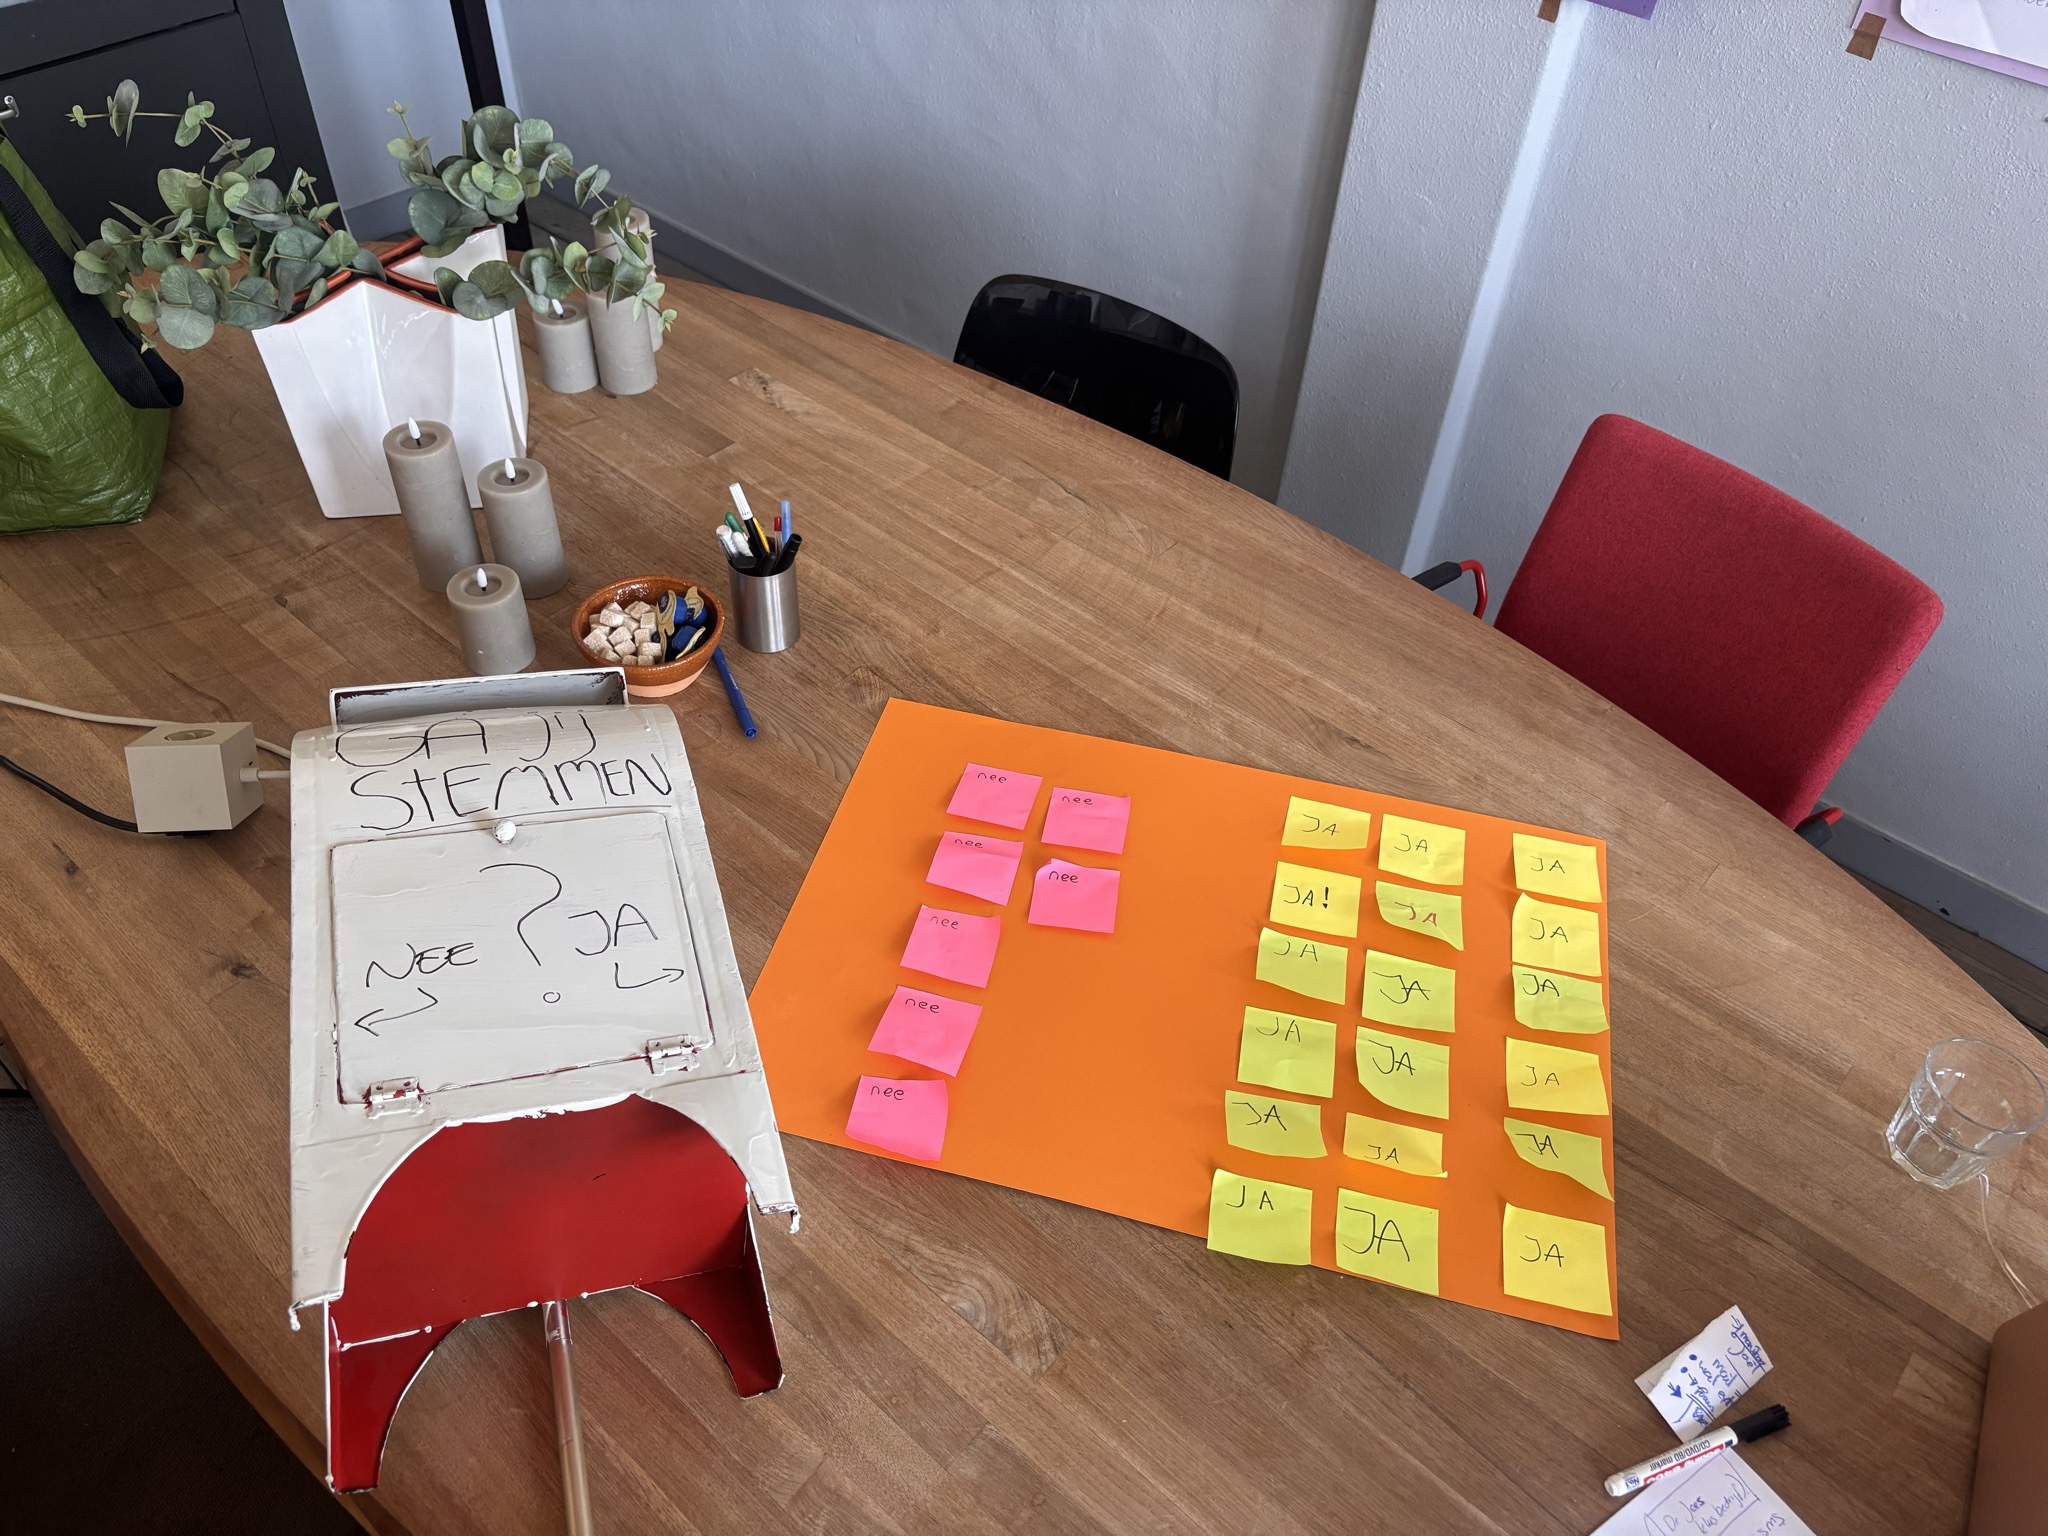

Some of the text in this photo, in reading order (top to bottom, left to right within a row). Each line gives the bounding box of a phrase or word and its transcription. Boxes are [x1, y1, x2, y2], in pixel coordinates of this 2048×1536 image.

[335, 717, 488, 768] GA
[977, 771, 1007, 784] nee
[350, 752, 672, 830] STEMMEN
[1061, 795, 1093, 806] nee
[1302, 813, 1341, 837] JA
[954, 838, 983, 849] nee
[1393, 832, 1429, 853] JA
[1048, 870, 1079, 884] nee
[1530, 856, 1566, 874] JA
[1283, 883, 1330, 910] JA!
[929, 915, 959, 931] nee
[1394, 901, 1438, 927] JA
[568, 903, 659, 956] JA
[1529, 917, 1569, 944] JA
[1273, 940, 1319, 963] JA
[366, 942, 479, 988] NEE
[1372, 971, 1431, 1005] JA
[1521, 973, 1561, 998] JA
[904, 998, 940, 1014] nee
[1255, 1016, 1302, 1043] JA
[1367, 1039, 1416, 1077] JA
[1520, 1064, 1561, 1087] JA
[870, 1085, 904, 1101] nee
[1231, 1102, 1288, 1132] JA
[1363, 1144, 1400, 1165] JA
[1515, 1133, 1559, 1160] JA
[1225, 1185, 1274, 1211] JA
[1344, 1205, 1410, 1263] JA
[1519, 1234, 1565, 1268] JA
[1649, 1457, 1674, 1472] marker
